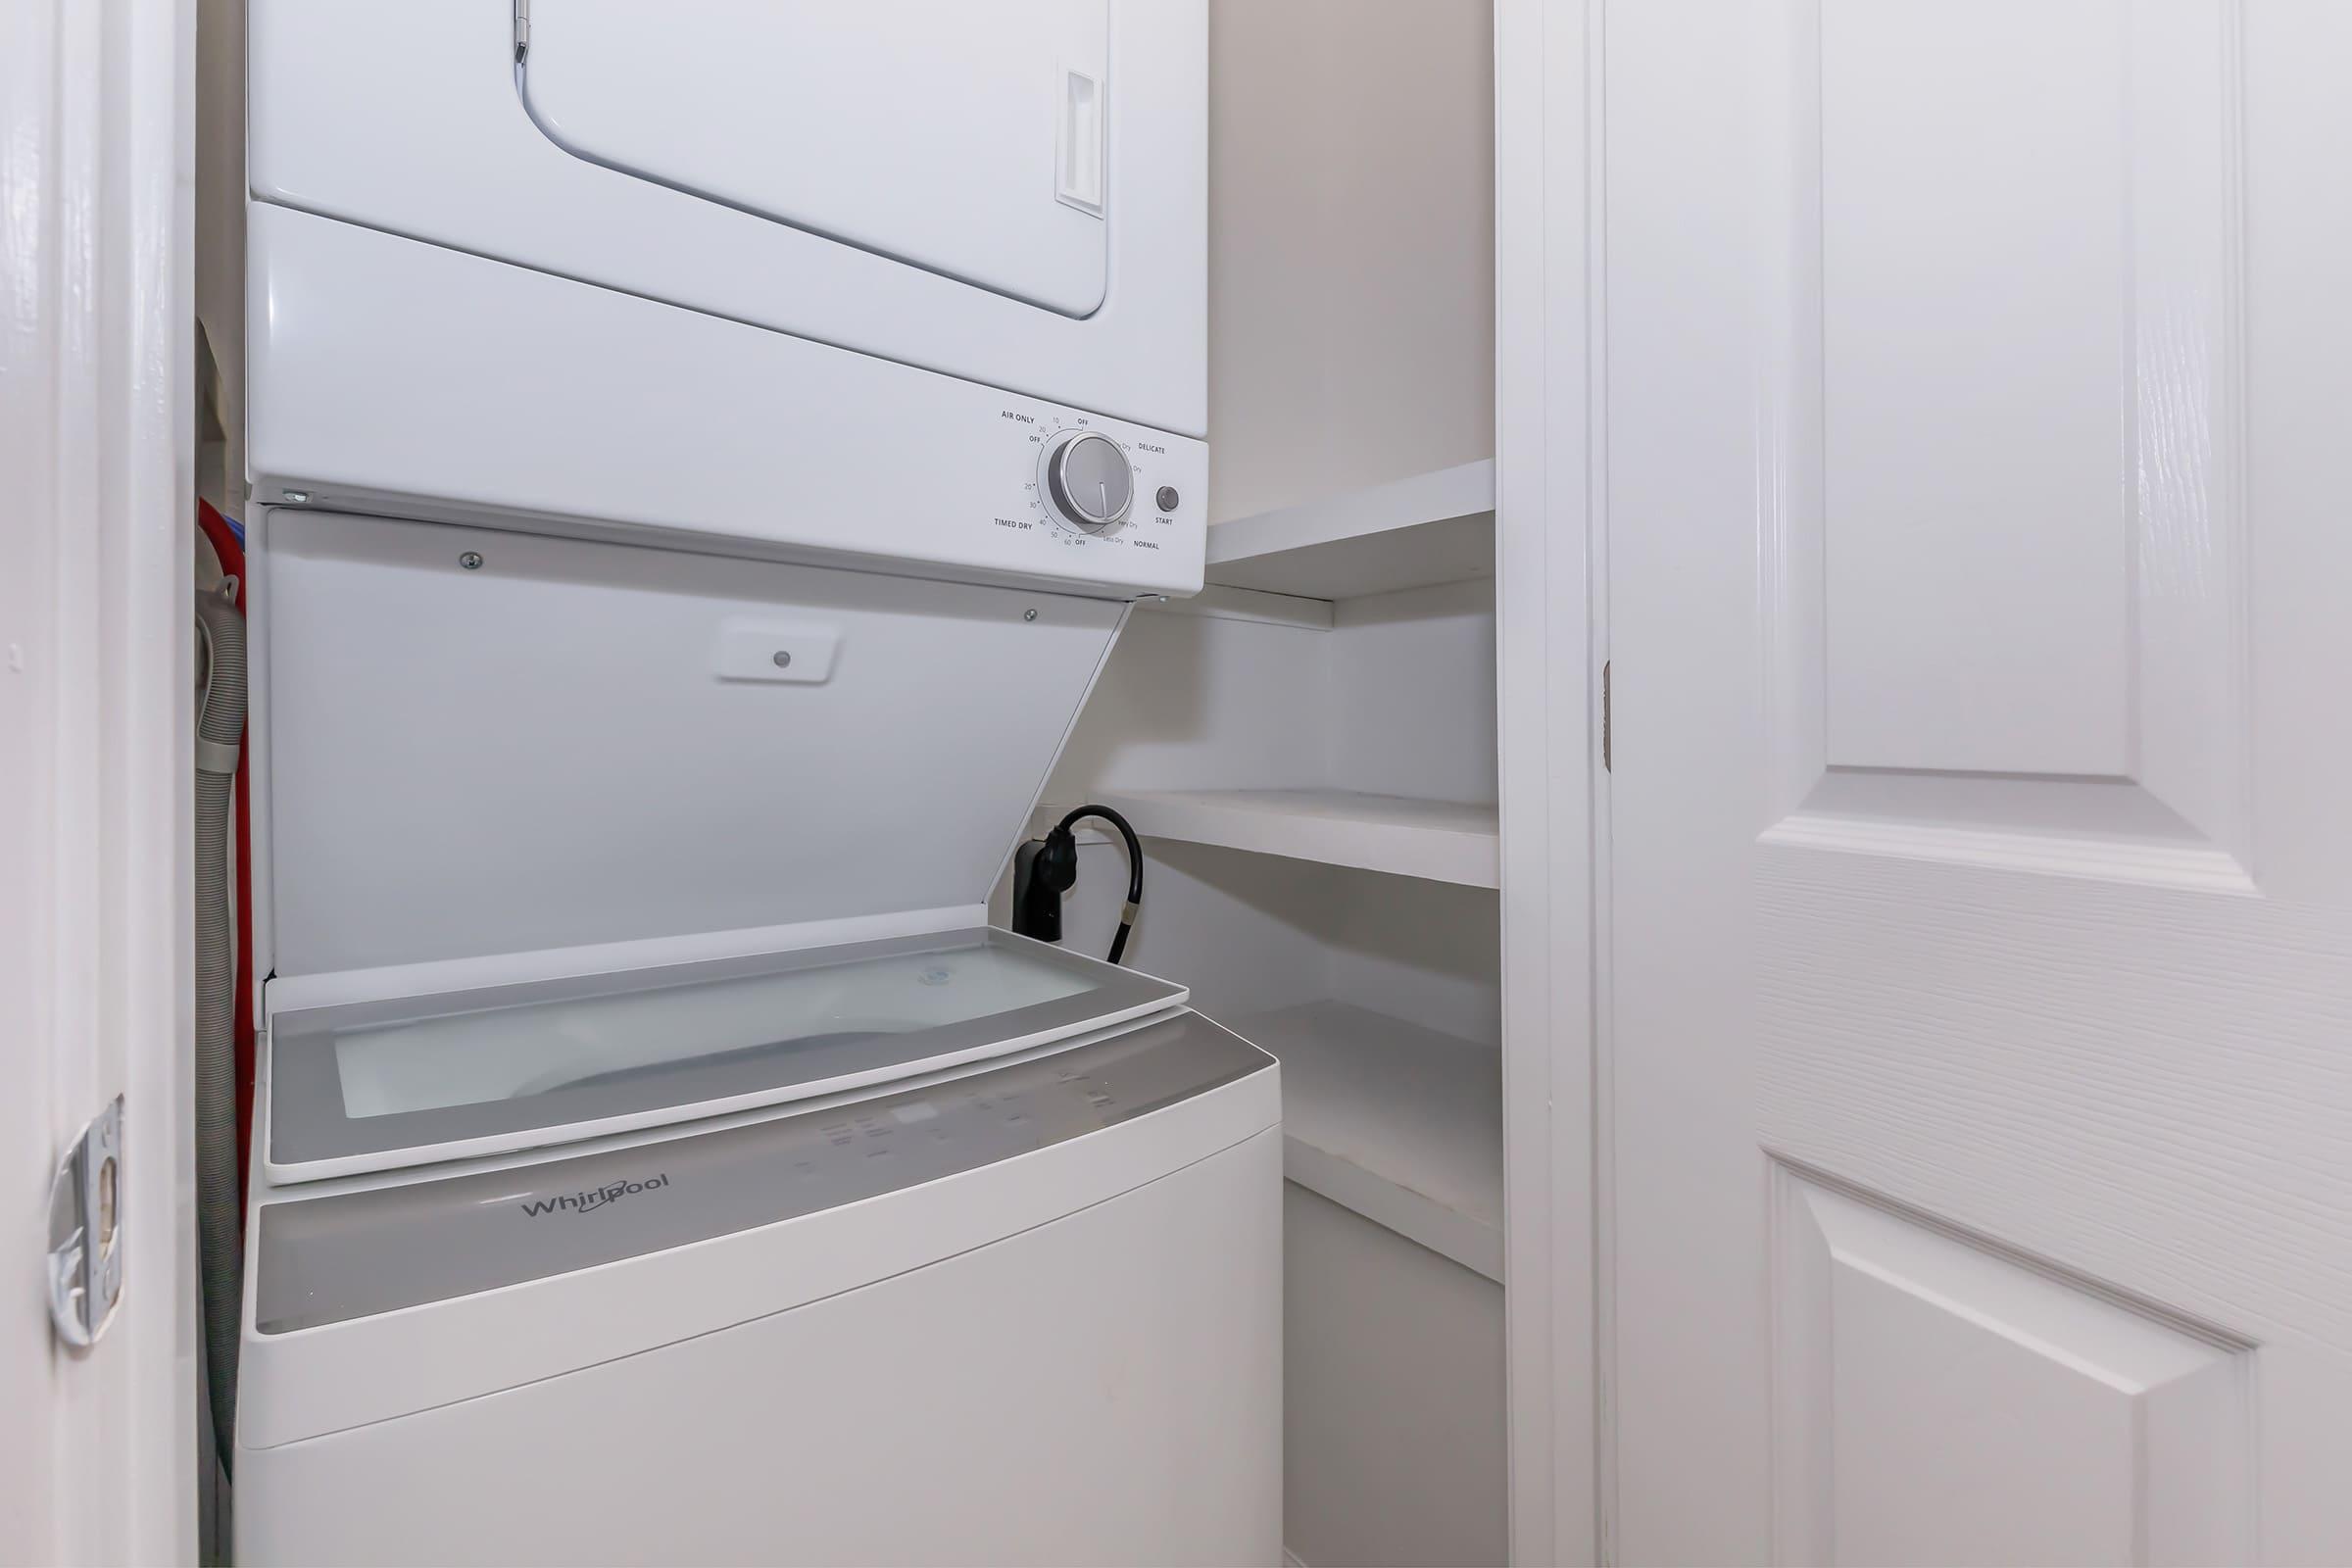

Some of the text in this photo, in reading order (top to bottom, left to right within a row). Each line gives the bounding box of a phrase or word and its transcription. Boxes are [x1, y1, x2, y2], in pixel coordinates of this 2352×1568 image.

[1002, 411, 1035, 424] AIR ONLY
[1138, 442, 1165, 455] DELICATE
[994, 517, 1033, 530] TIMED DRY
[1154, 517, 1173, 526] START
[1133, 540, 1160, 550] NORMAL
[521, 1173, 669, 1217] Whirlpool
